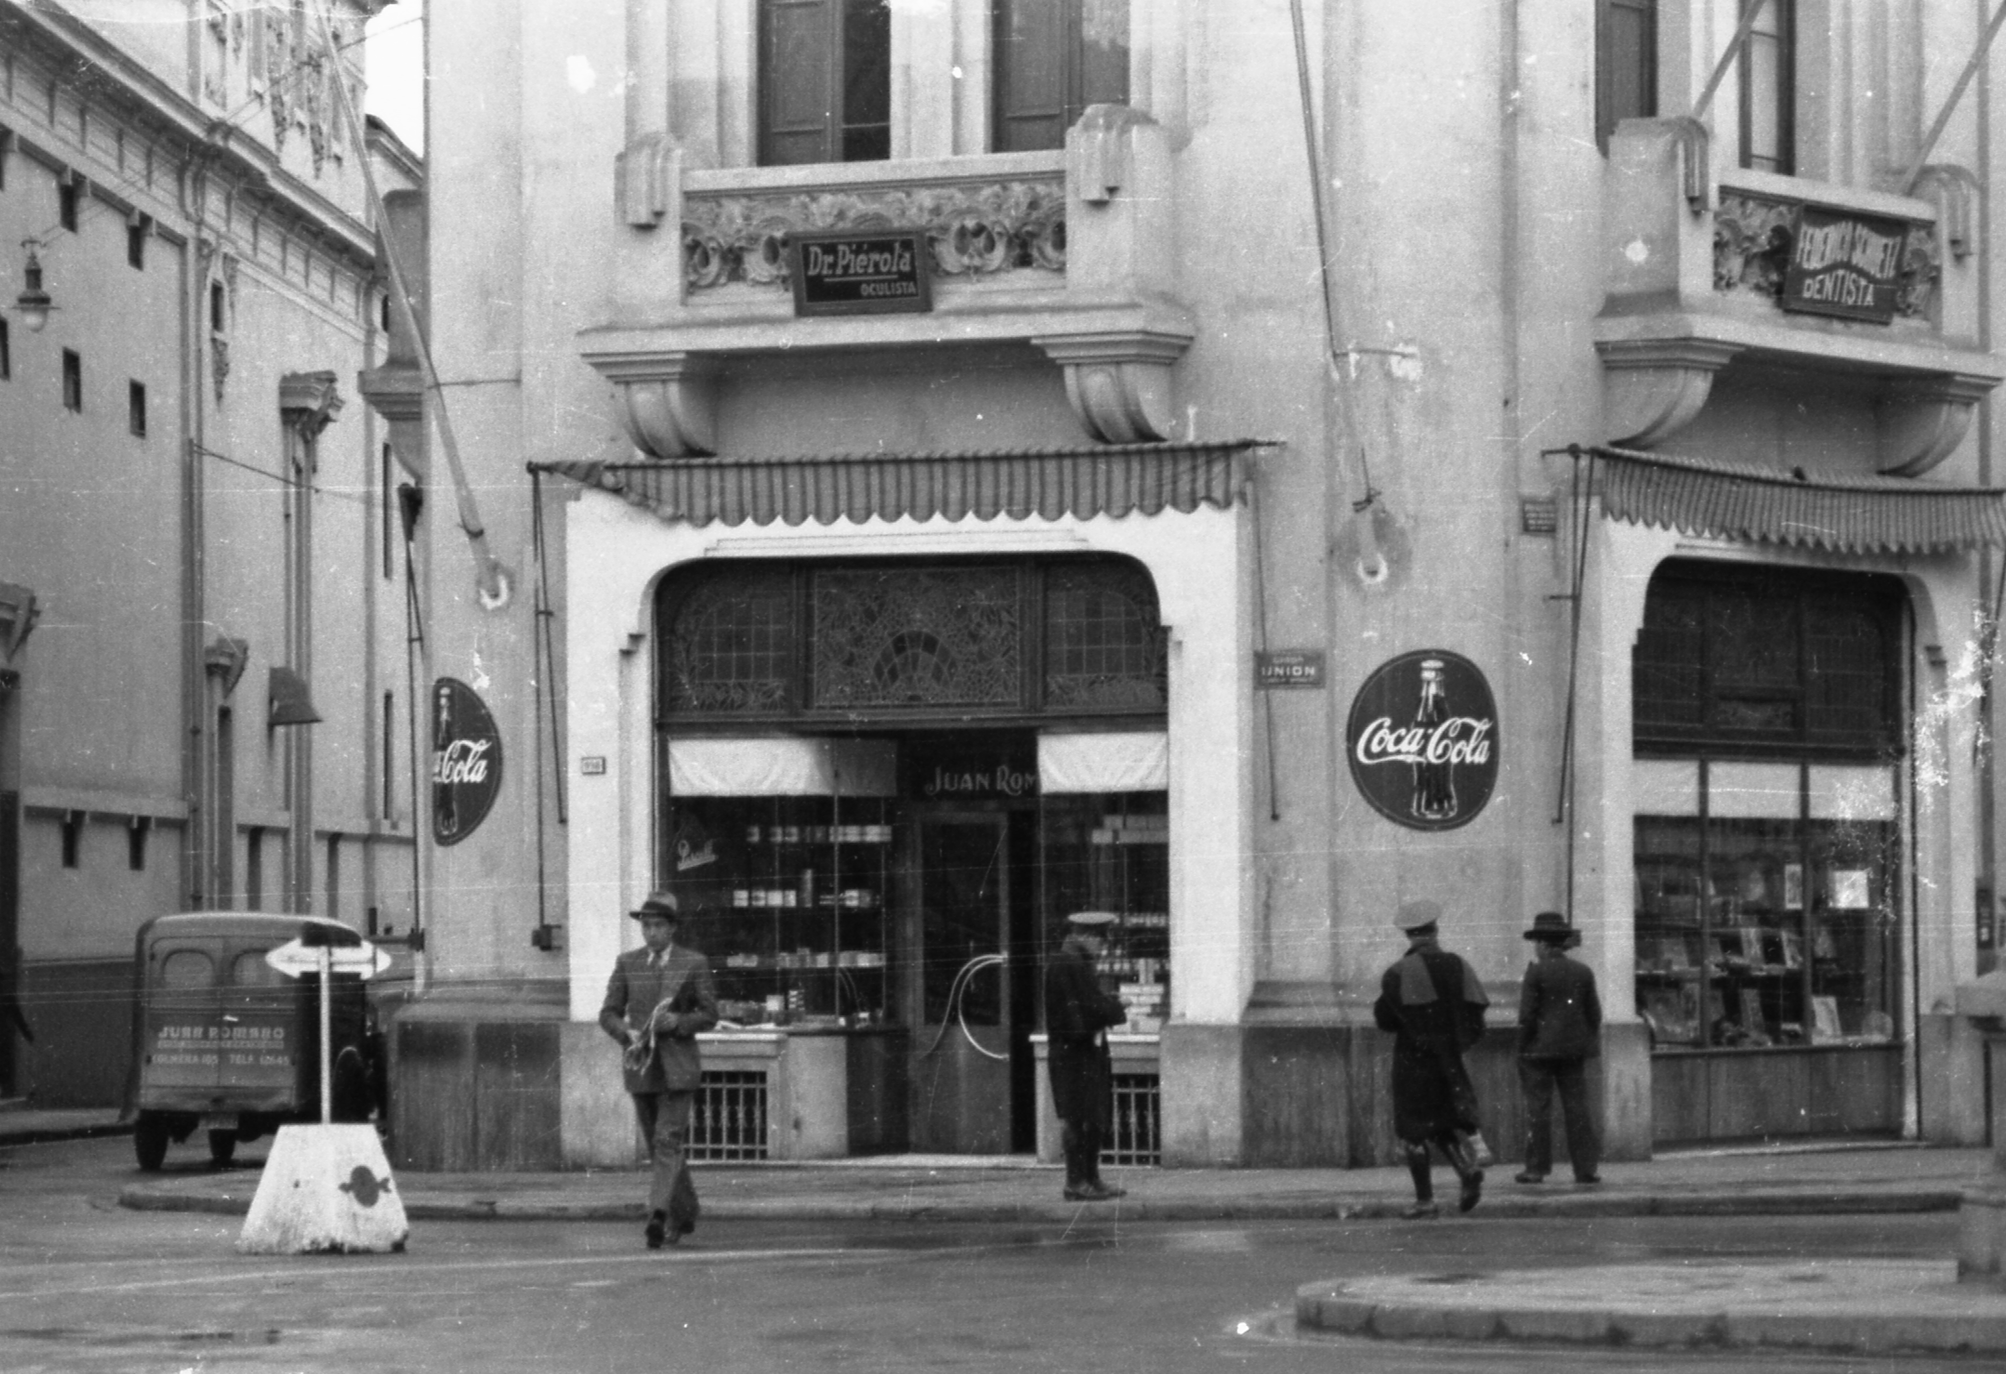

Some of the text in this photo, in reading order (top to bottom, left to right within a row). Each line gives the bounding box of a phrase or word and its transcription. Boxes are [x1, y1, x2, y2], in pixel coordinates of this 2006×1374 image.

[860, 281, 917, 296] OCULISTA
[1802, 269, 1875, 306] DENTISTA
[1261, 665, 1317, 677] UNION
[924, 765, 990, 796] JUAN
[158, 1026, 203, 1039] JUAN
